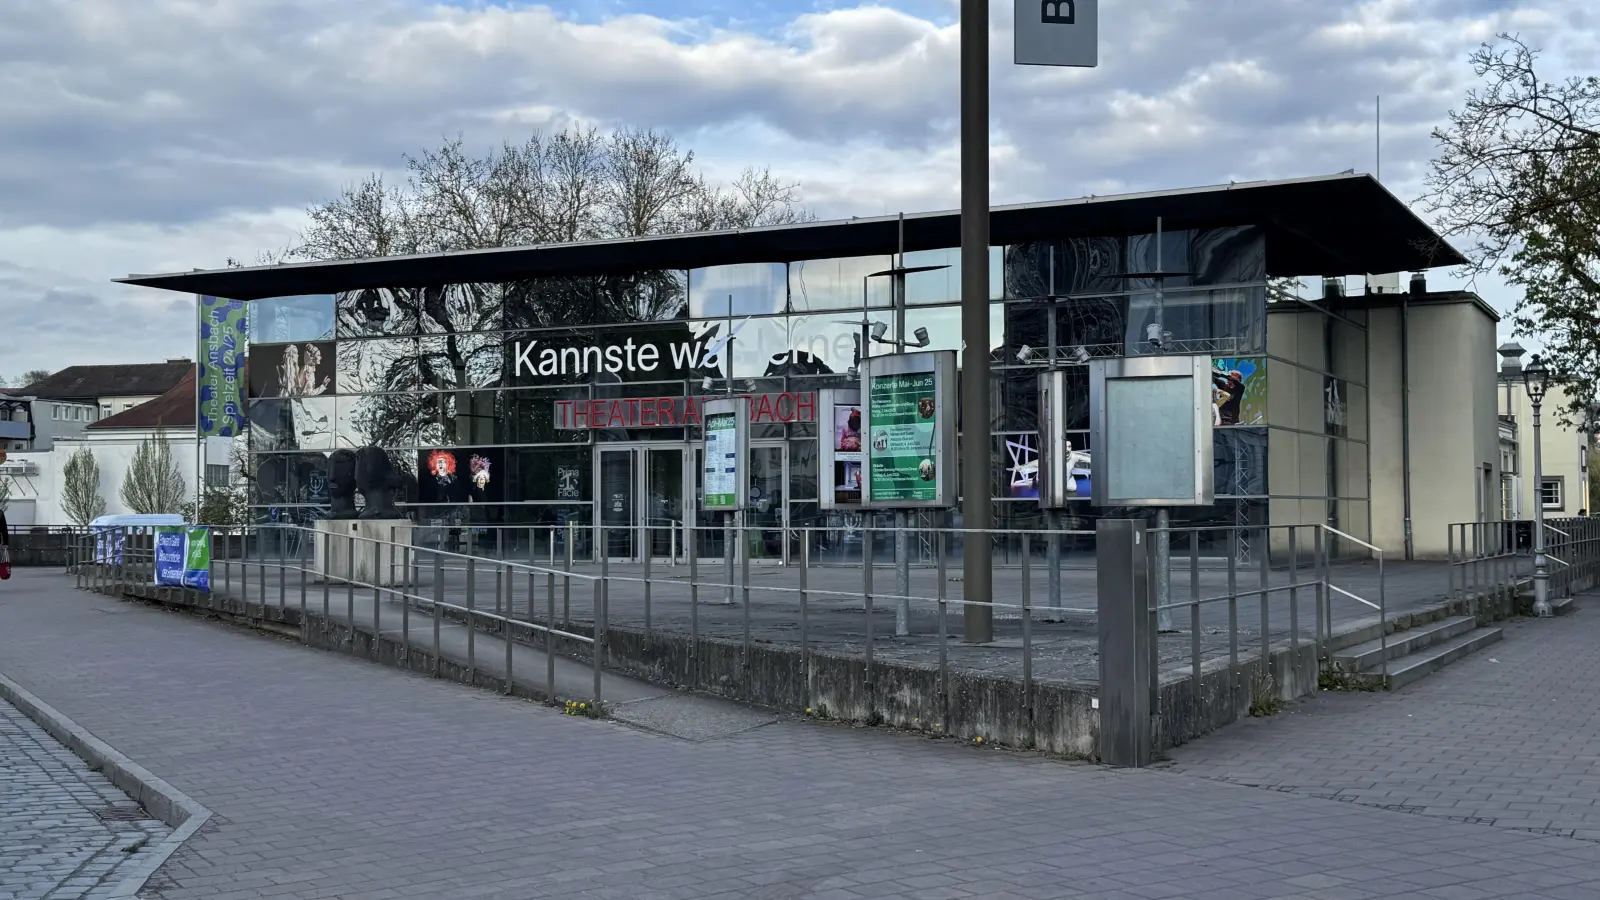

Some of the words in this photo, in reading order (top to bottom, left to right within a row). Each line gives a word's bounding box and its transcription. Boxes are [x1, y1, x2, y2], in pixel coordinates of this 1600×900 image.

[208, 310, 219, 370] Ansbach
[222, 326, 235, 366] 24/25
[515, 337, 659, 377] Kannste
[208, 373, 218, 424] Theater
[222, 367, 236, 424] Spielzeit
[871, 382, 898, 390] Konzerte
[924, 378, 933, 386] 25
[556, 397, 675, 428] THEATER
[558, 468, 580, 477] Prima
[558, 489, 579, 497] Facie
